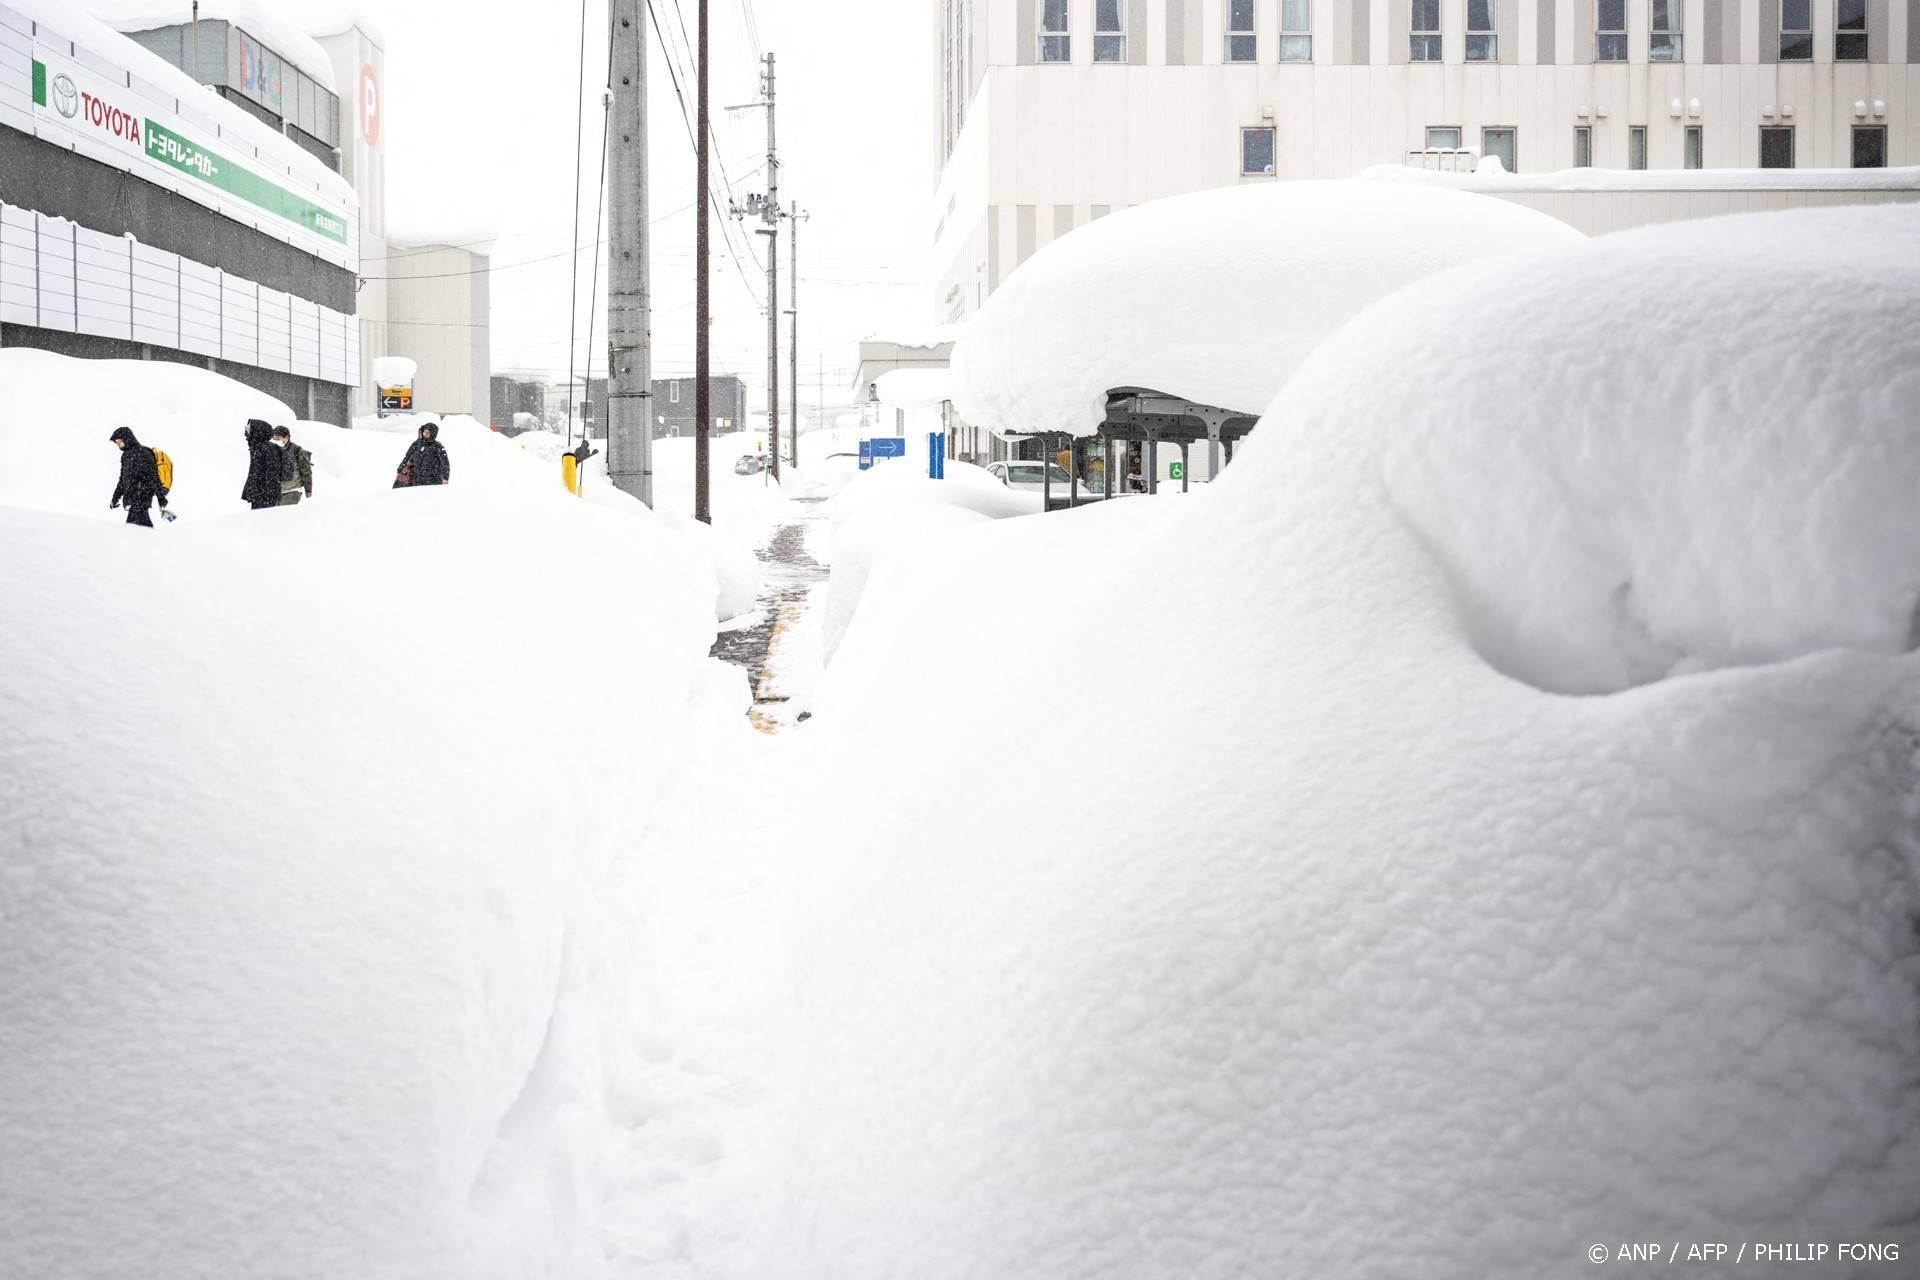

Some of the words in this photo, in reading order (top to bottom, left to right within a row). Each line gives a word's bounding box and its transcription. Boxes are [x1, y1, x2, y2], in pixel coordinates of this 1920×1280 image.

[81, 91, 141, 145] TOYOTA
[148, 128, 219, 177] トヨタレンタカー
[400, 396, 411, 409] P
